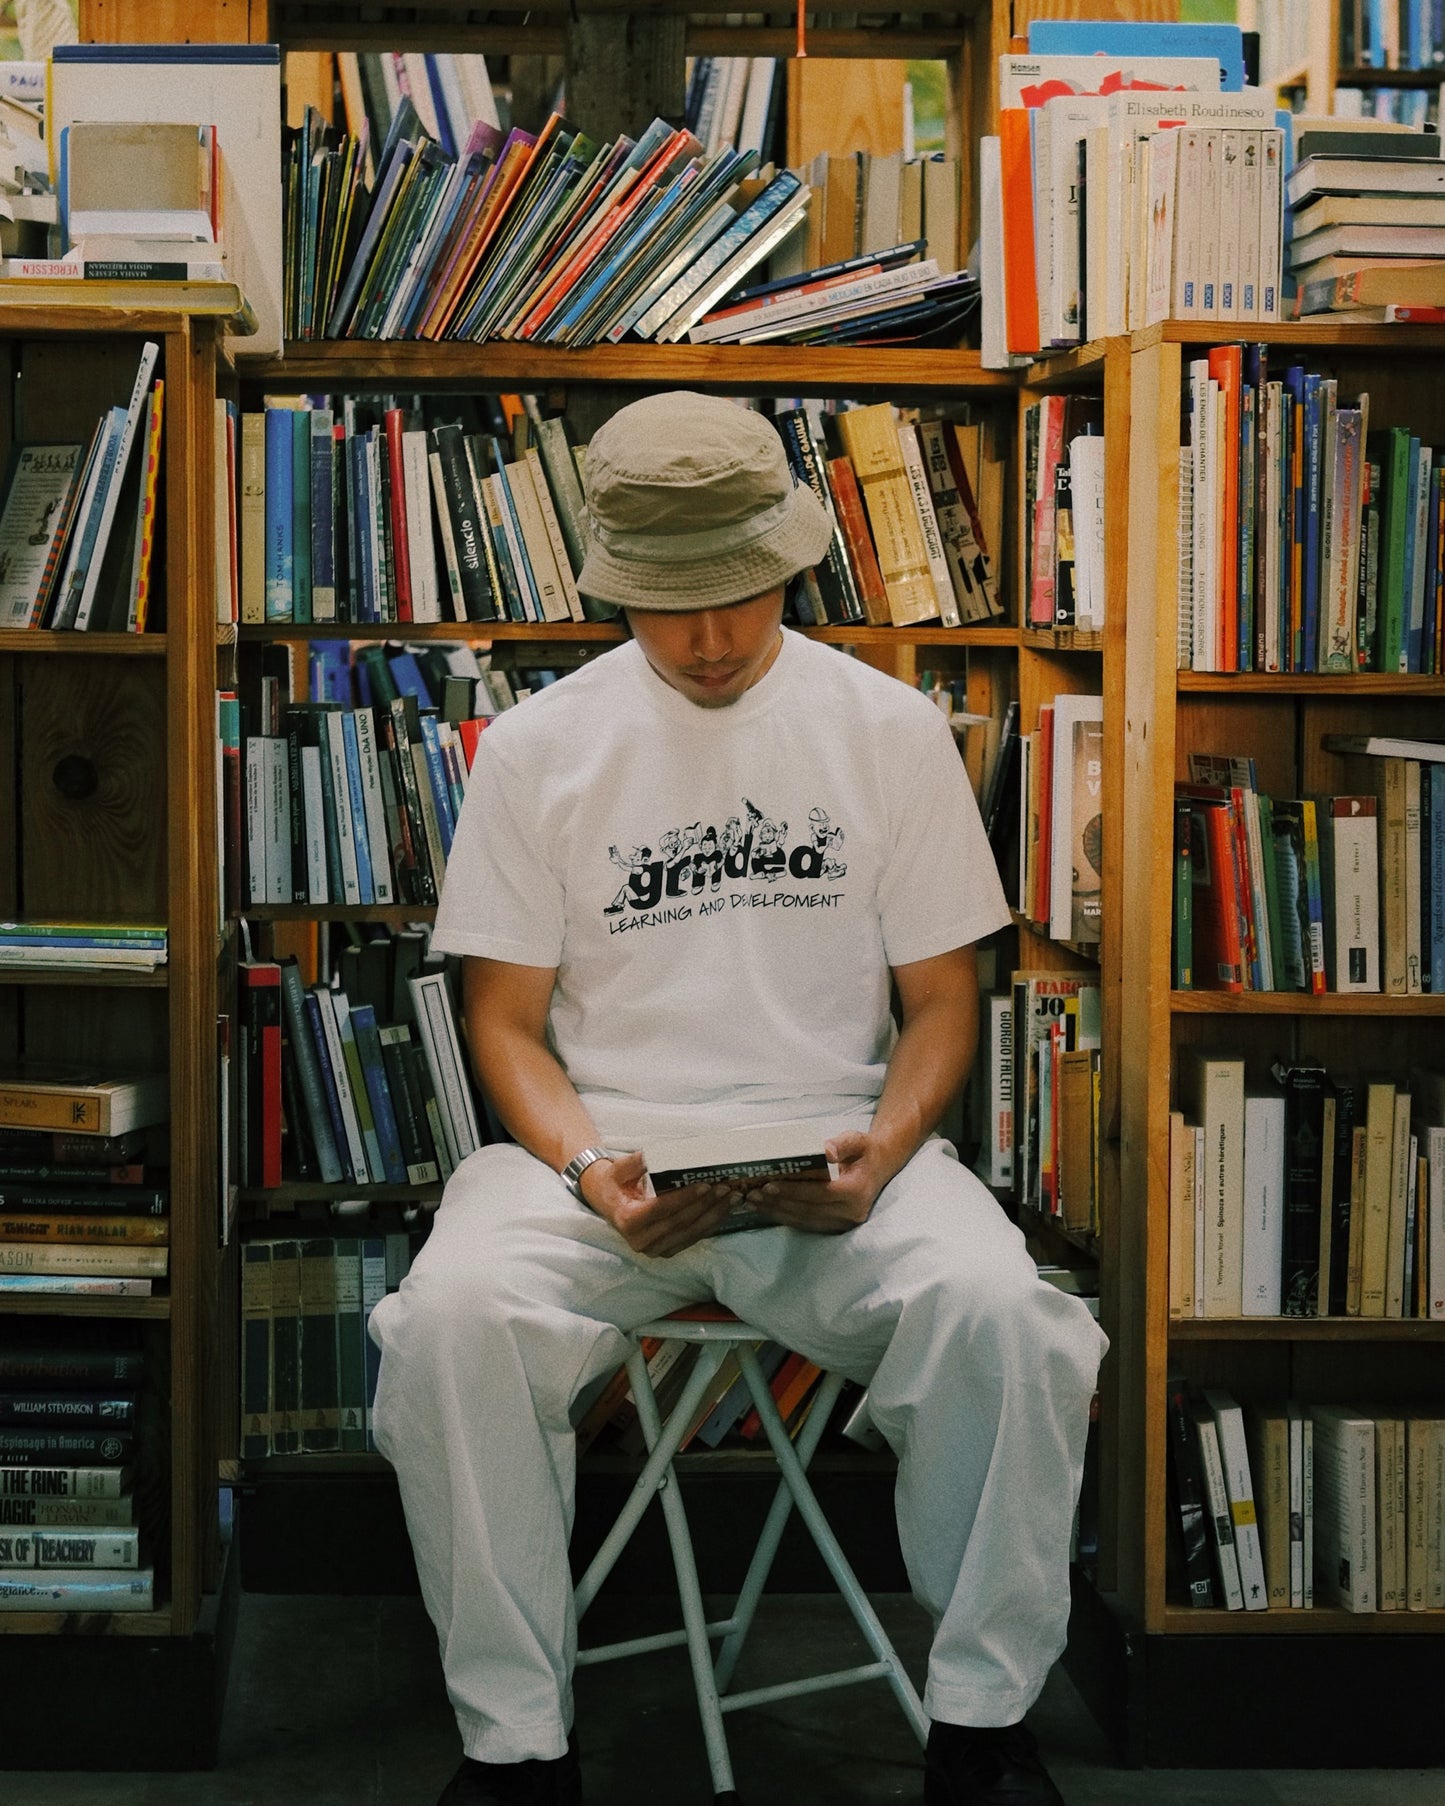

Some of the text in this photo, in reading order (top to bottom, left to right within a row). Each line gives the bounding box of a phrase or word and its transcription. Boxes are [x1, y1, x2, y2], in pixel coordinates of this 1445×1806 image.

[1127, 103, 1265, 118] Elisabeth Roudinesco
[22, 263, 79, 275] VERGESSEN
[794, 416, 811, 453] GAULLE
[1200, 429, 1206, 440] DE
[275, 523, 284, 587] TOM HANKS
[460, 520, 479, 569] silencio
[609, 906, 692, 935] LEARNING
[699, 898, 725, 916] AND
[1000, 1011, 1012, 1055] GIORGIO
[1000, 1058, 1012, 1101] FALETTI
[1218, 1124, 1226, 1162] hérétiques
[682, 1159, 812, 1181] Counting the
[1219, 1188, 1224, 1196] et
[13, 1402, 93, 1414] WILLIAM STEVENSON
[0, 1436, 96, 1451] Espionage in America
[2, 1469, 68, 1495] THE RING
[15, 1539, 30, 1562] OF
[31, 1531, 97, 1568] TREACHERY
